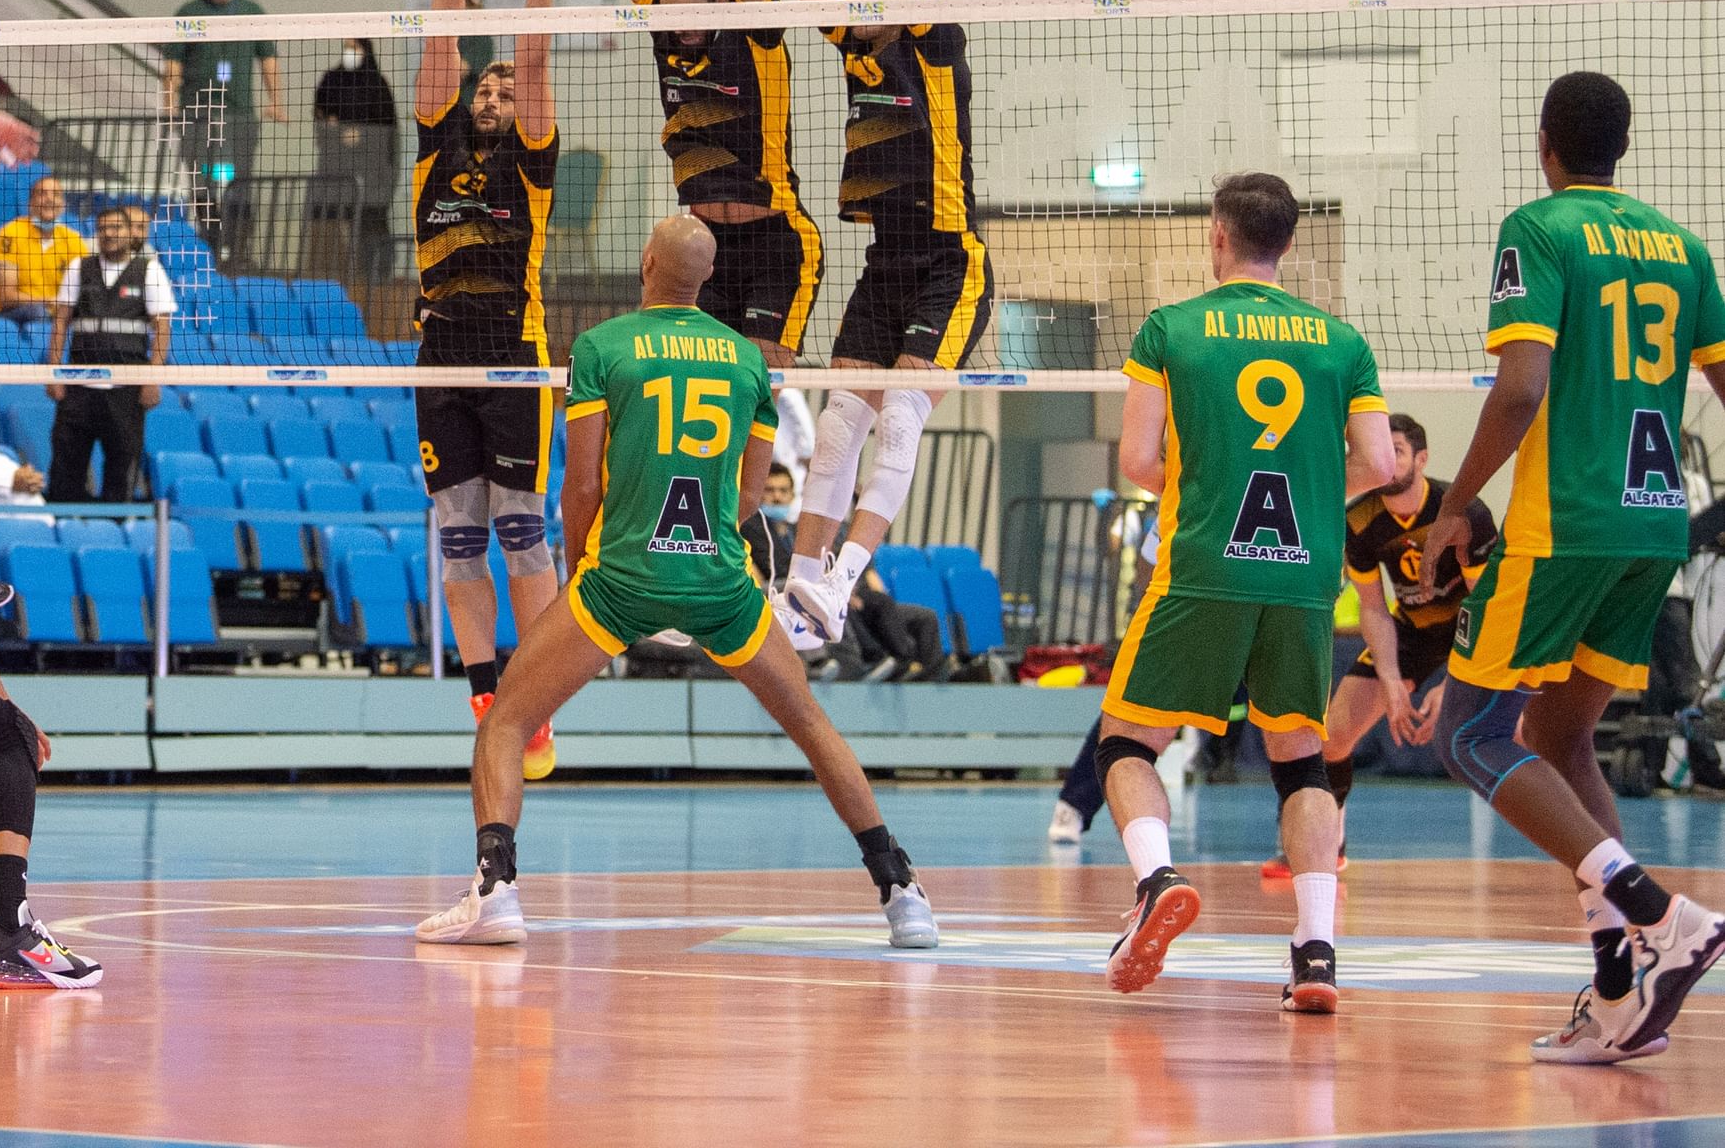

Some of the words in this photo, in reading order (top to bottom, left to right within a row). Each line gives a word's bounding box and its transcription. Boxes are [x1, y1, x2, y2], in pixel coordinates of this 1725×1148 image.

[391, 13, 424, 26] NAS
[615, 8, 649, 21] NAS
[848, 1, 885, 14] NAS
[175, 19, 207, 31] NAS
[1583, 223, 1611, 255] AL
[1205, 310, 1230, 339] AL
[1236, 313, 1328, 346] JAWAREH
[1600, 278, 1680, 384] 13
[633, 334, 657, 360] AL
[661, 335, 738, 365] JAWAREH
[643, 375, 732, 459] 15
[1236, 359, 1305, 451] 9
[419, 440, 439, 472] 8
[1625, 409, 1681, 491] A
[651, 475, 712, 542] A
[1230, 470, 1302, 549] A
[647, 539, 717, 555] ALSAYEGH
[1223, 543, 1309, 564] ALSAYEGH
